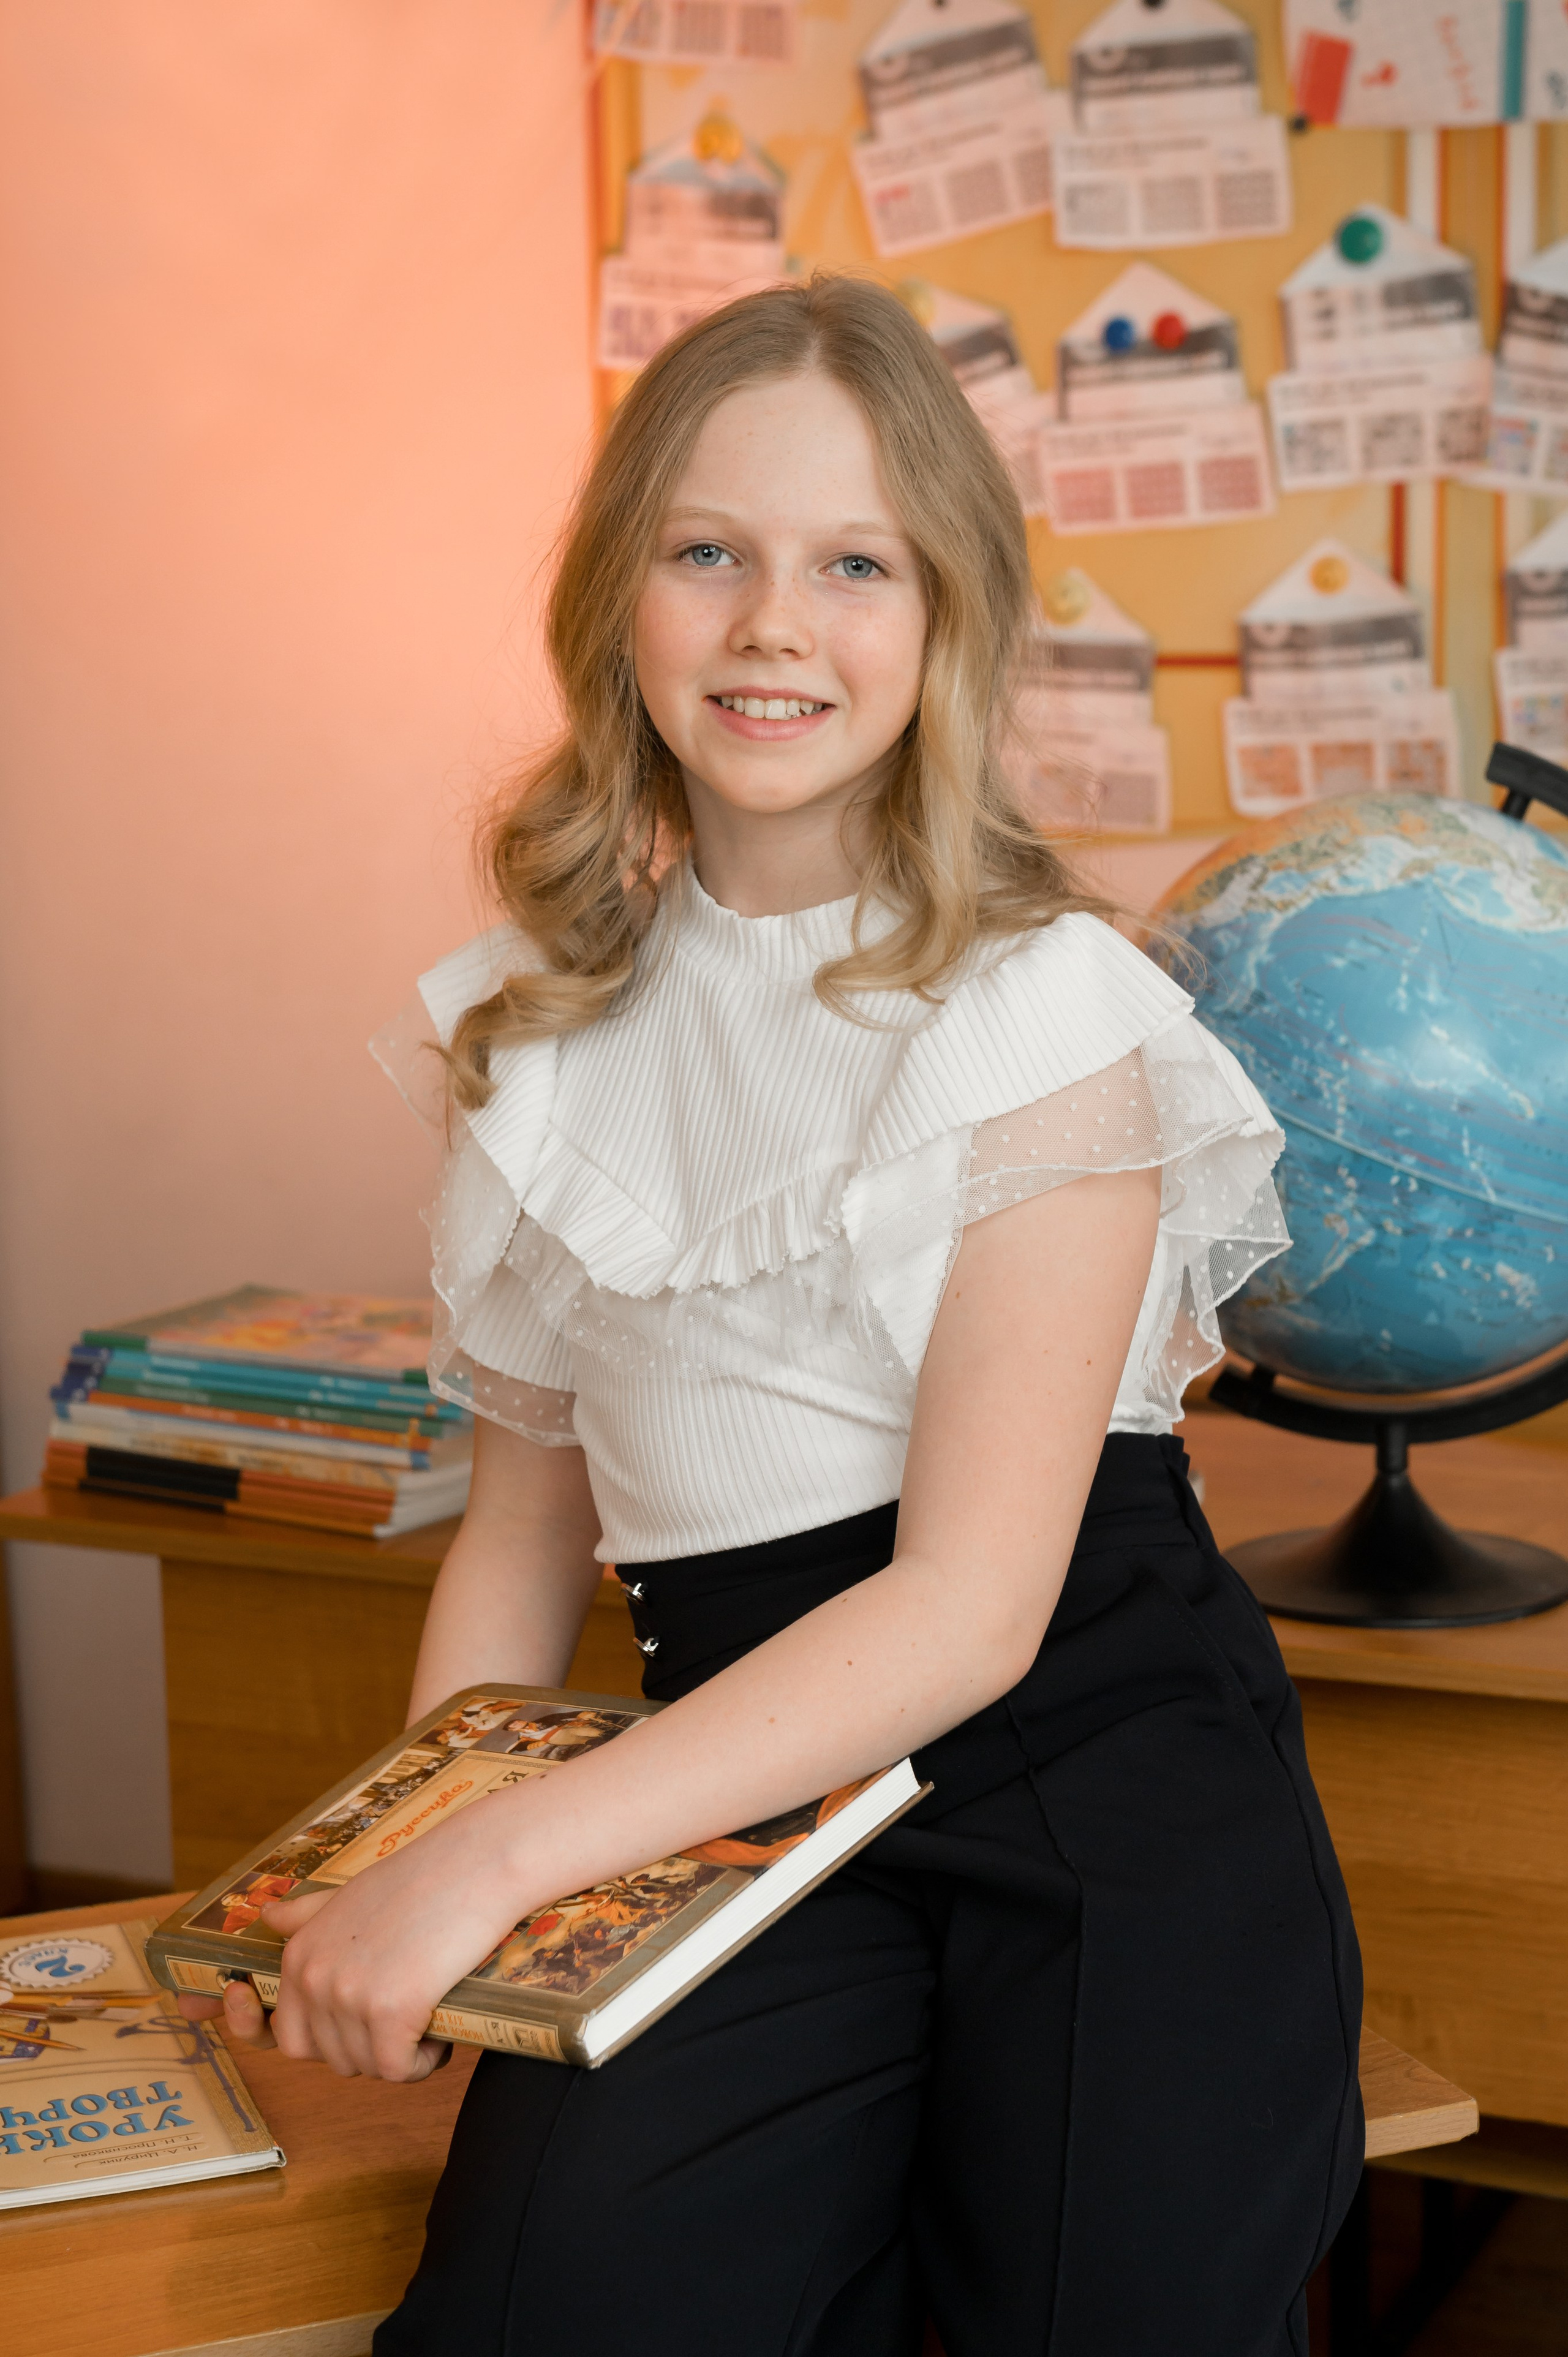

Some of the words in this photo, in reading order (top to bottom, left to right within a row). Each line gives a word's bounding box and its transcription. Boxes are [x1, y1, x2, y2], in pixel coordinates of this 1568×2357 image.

[35, 1955, 86, 1978] 2
[0, 2081, 183, 2129] ТВОРЧ
[72, 2141, 156, 2159] Проснякова
[99, 2152, 159, 2166] Цирулик
